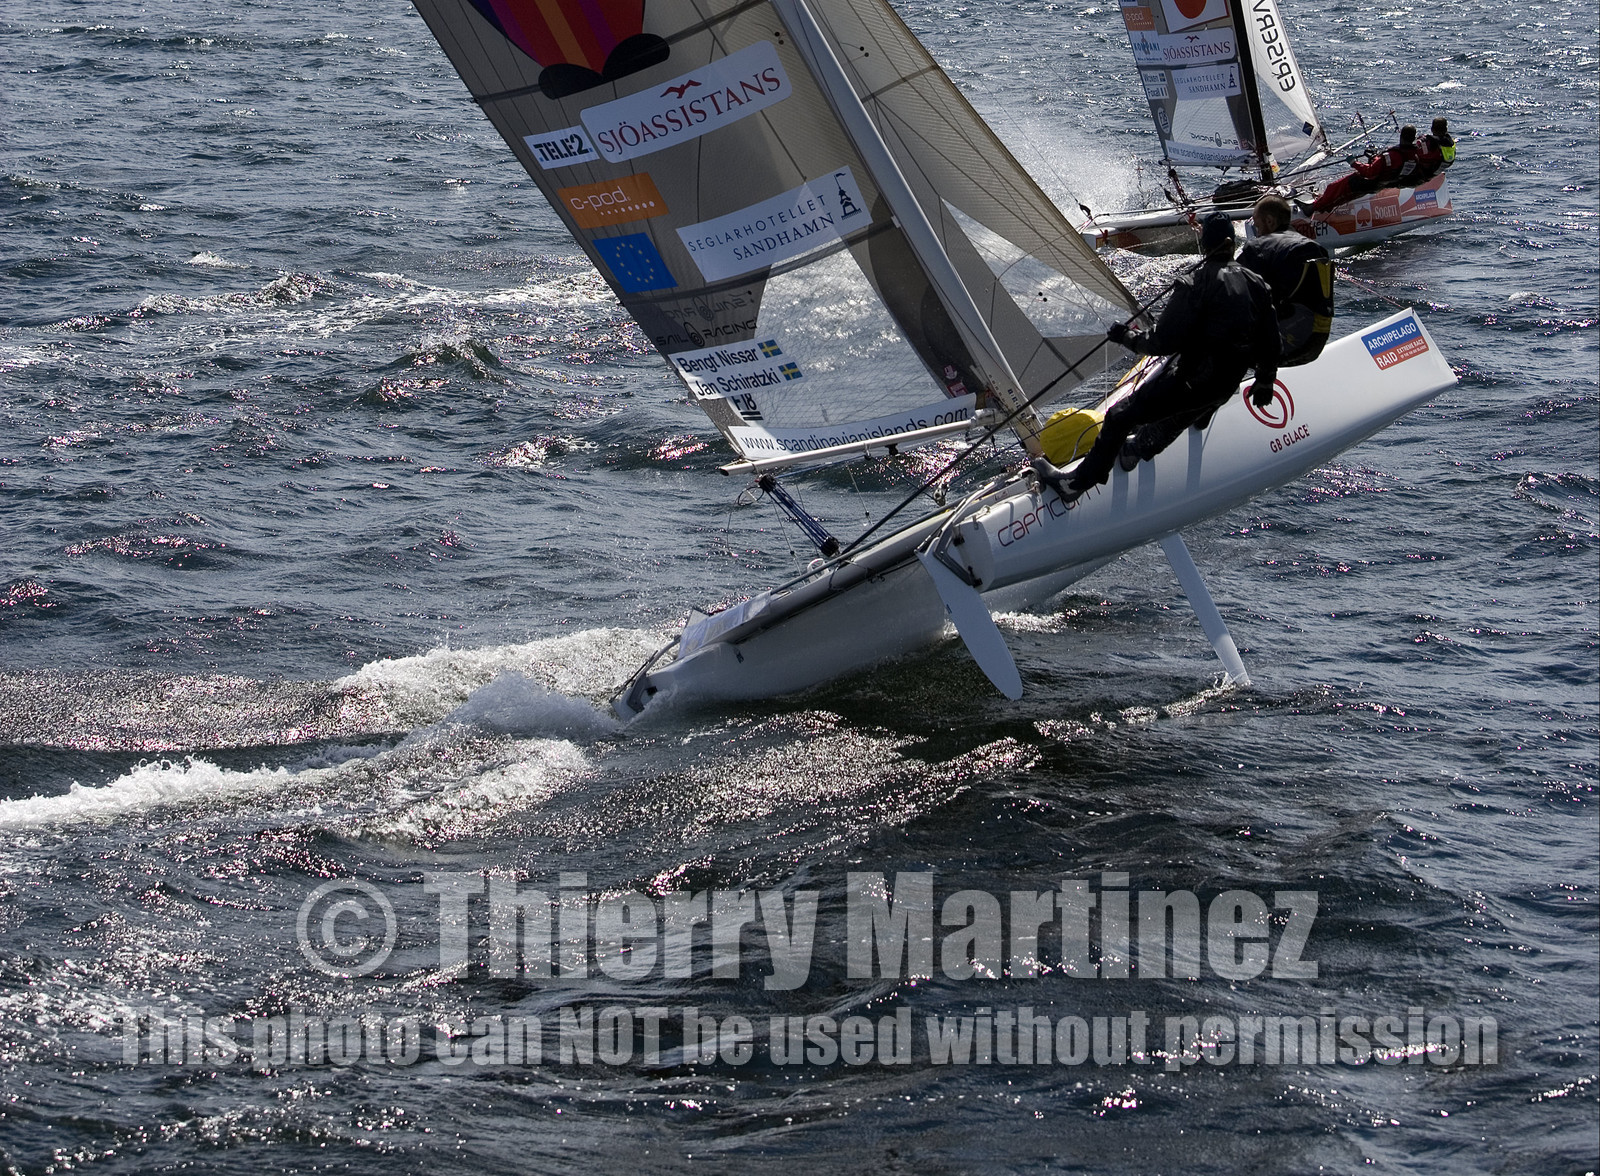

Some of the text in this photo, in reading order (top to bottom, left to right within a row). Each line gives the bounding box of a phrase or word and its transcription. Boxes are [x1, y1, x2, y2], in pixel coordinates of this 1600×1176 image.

[1162, 41, 1231, 62] SJÖASSISTANS
[1188, 83, 1226, 94] SANDHAMN
[597, 67, 780, 155] SJÖASSISTANS
[570, 185, 628, 211] c-pod
[688, 194, 826, 252] SEGLARHOTELLET
[1374, 205, 1398, 219] SOGETI
[733, 212, 835, 261] SANDHAMN
[657, 319, 758, 346] SAIL RACING
[1367, 322, 1417, 350] ARCHIPELAGO
[676, 347, 760, 373] Bengt Nissar
[1376, 351, 1398, 368] RAID
[695, 367, 781, 396] Jan Schiratzki
[1270, 424, 1310, 453] GB GLACE
